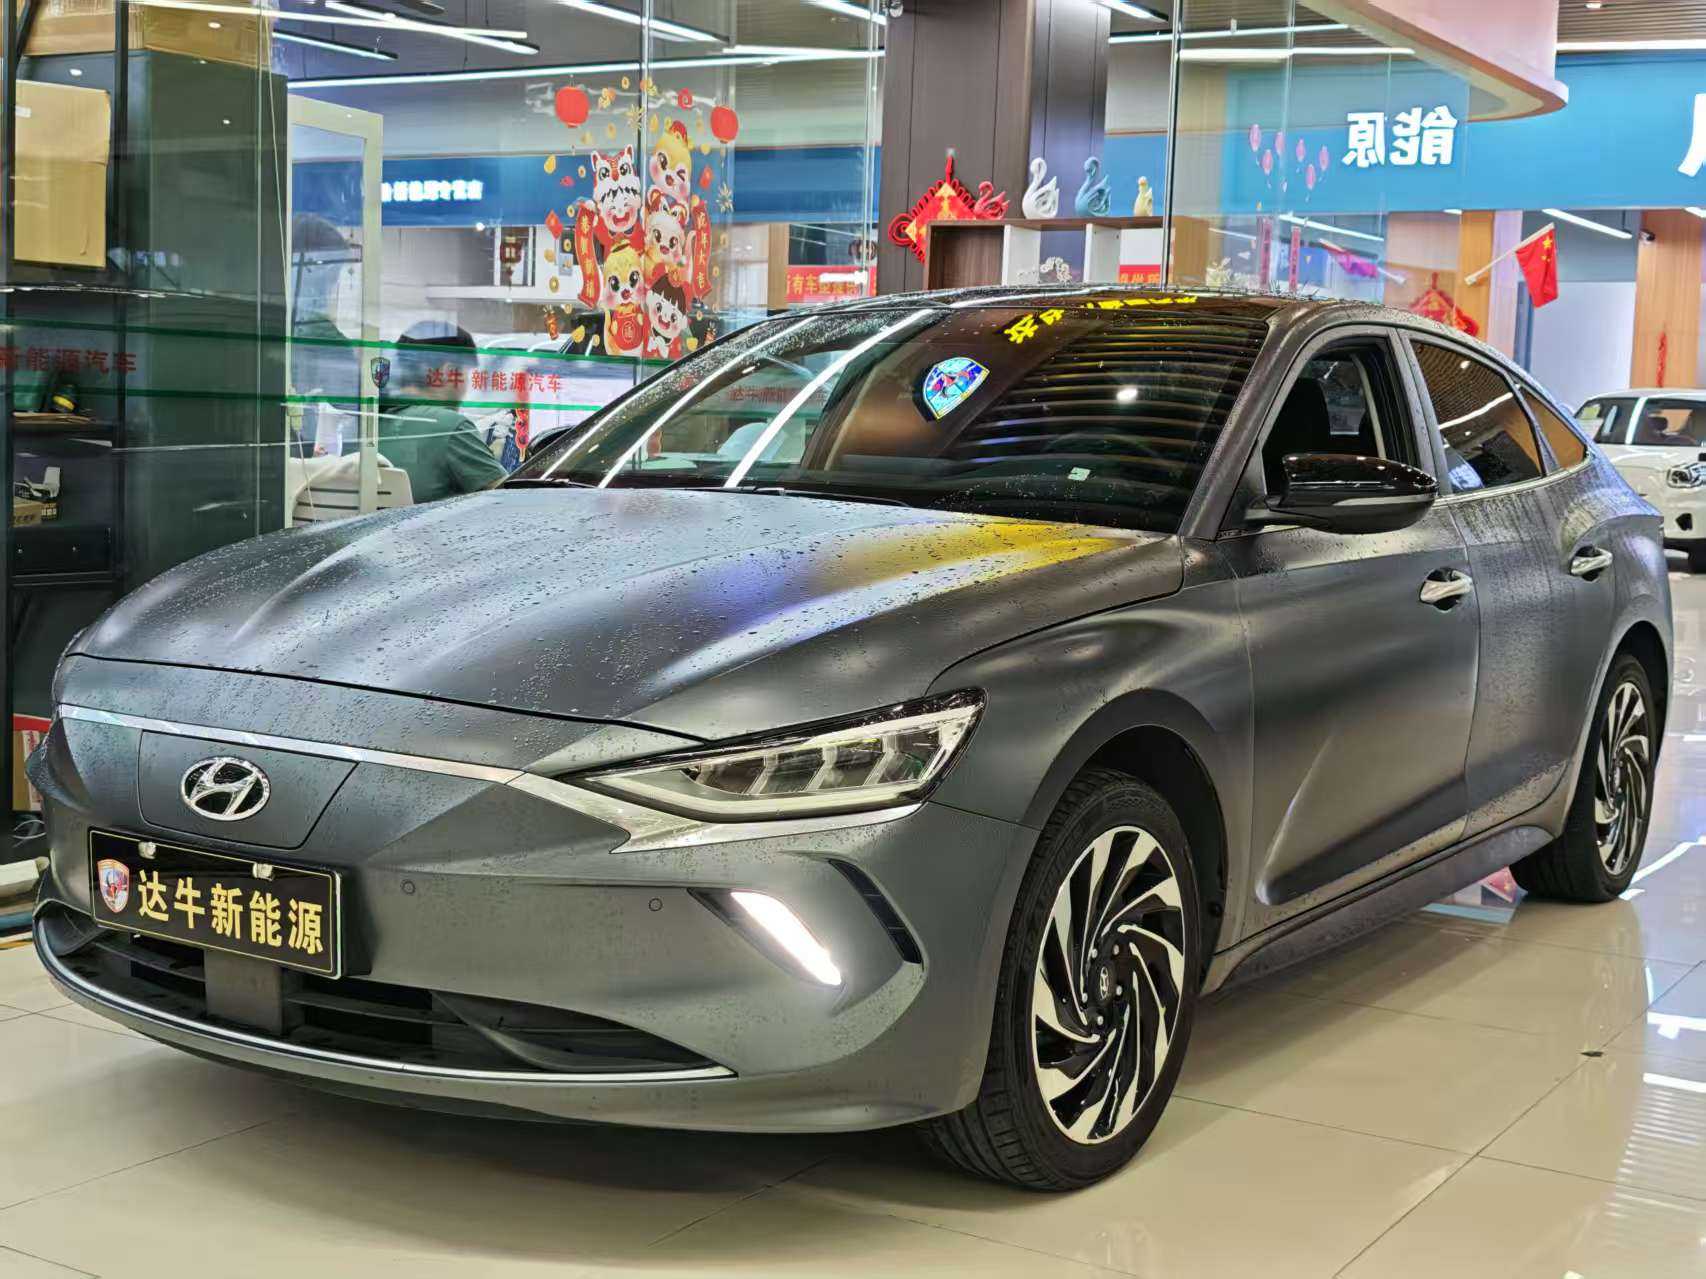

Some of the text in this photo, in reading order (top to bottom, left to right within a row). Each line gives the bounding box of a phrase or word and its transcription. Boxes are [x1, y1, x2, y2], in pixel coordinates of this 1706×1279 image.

[137, 869, 324, 955] 达牛新能源
